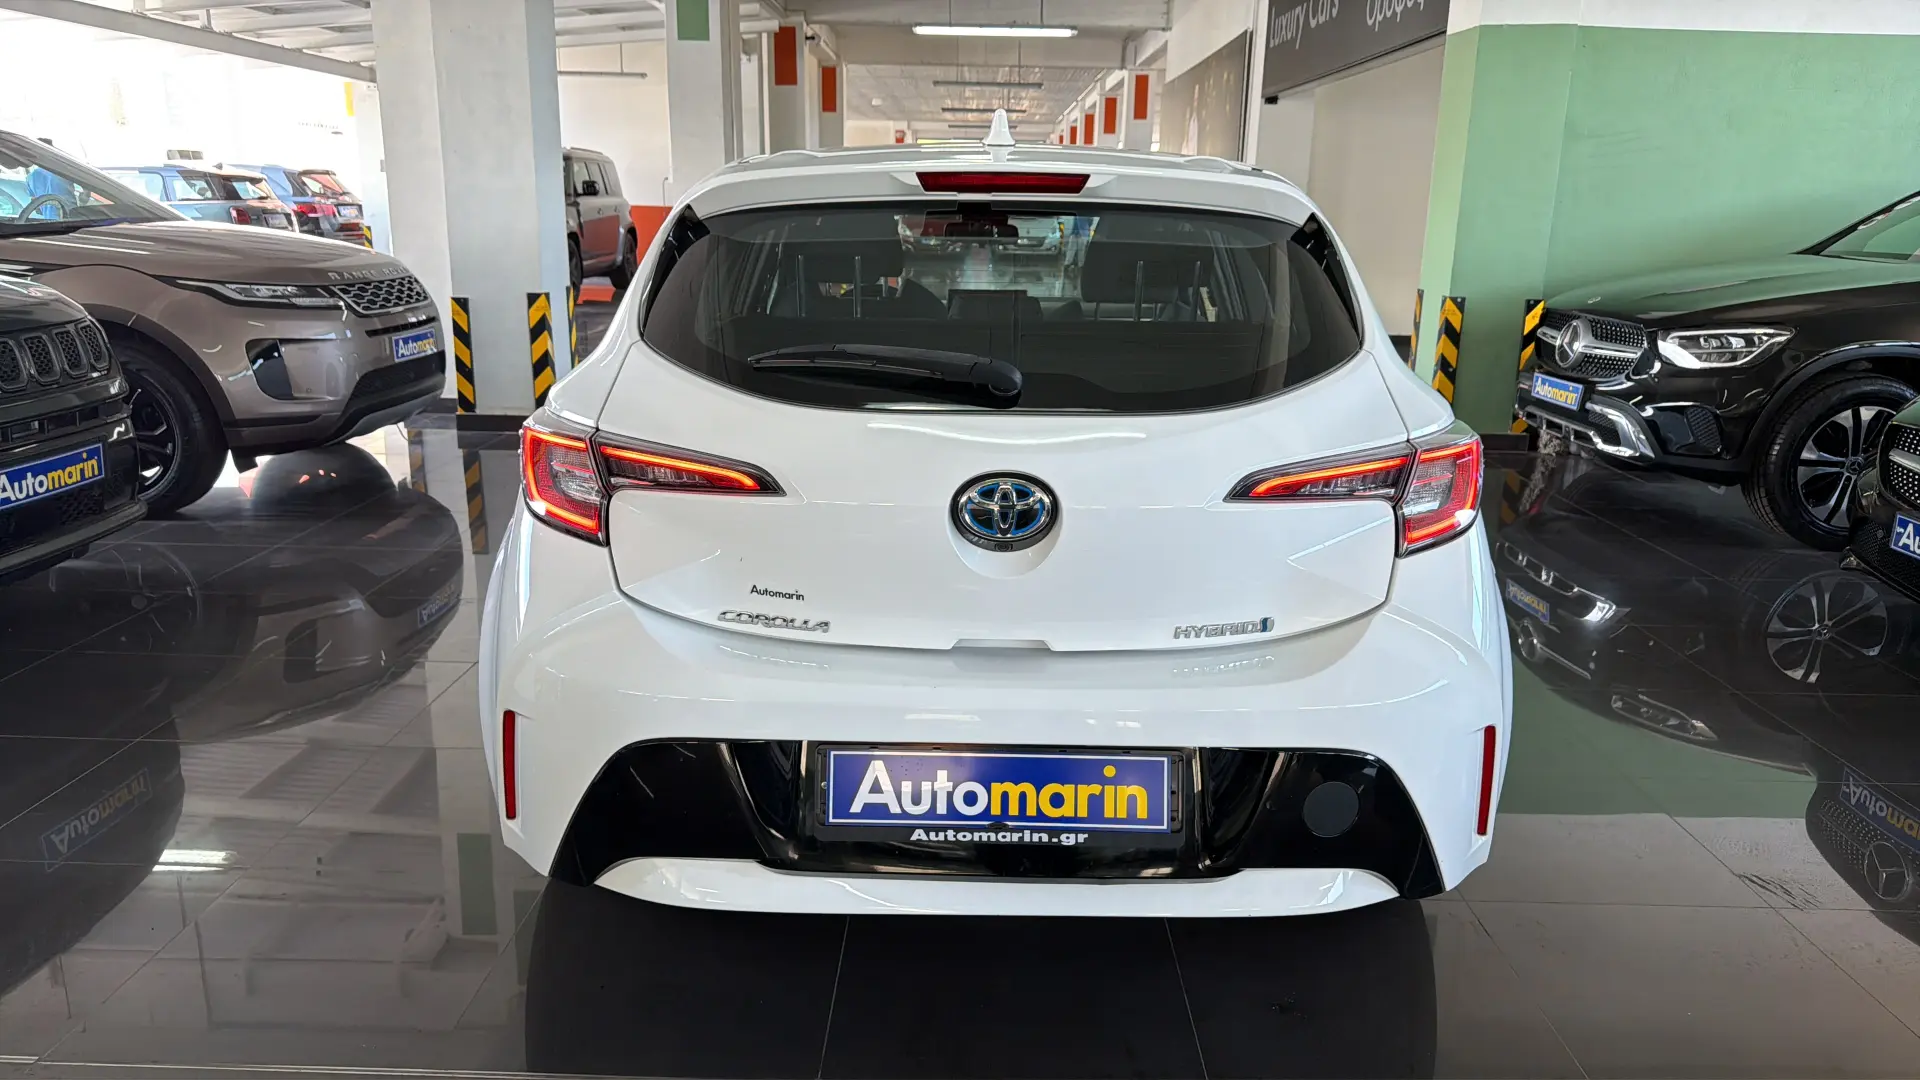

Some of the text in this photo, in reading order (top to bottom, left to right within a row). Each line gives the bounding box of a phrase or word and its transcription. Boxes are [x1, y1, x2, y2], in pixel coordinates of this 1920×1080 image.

[1269, 2, 1307, 49] Luxury
[328, 269, 379, 280] RANGE
[398, 333, 436, 356] Automarin
[1535, 377, 1577, 405] Automarin
[0, 452, 98, 501] Automarin
[750, 584, 804, 601] Automarin
[718, 610, 830, 633] COROLLA
[1173, 620, 1259, 639] HYBRID
[849, 760, 1148, 819] Automarin
[910, 828, 1089, 846] Automarin.gr
